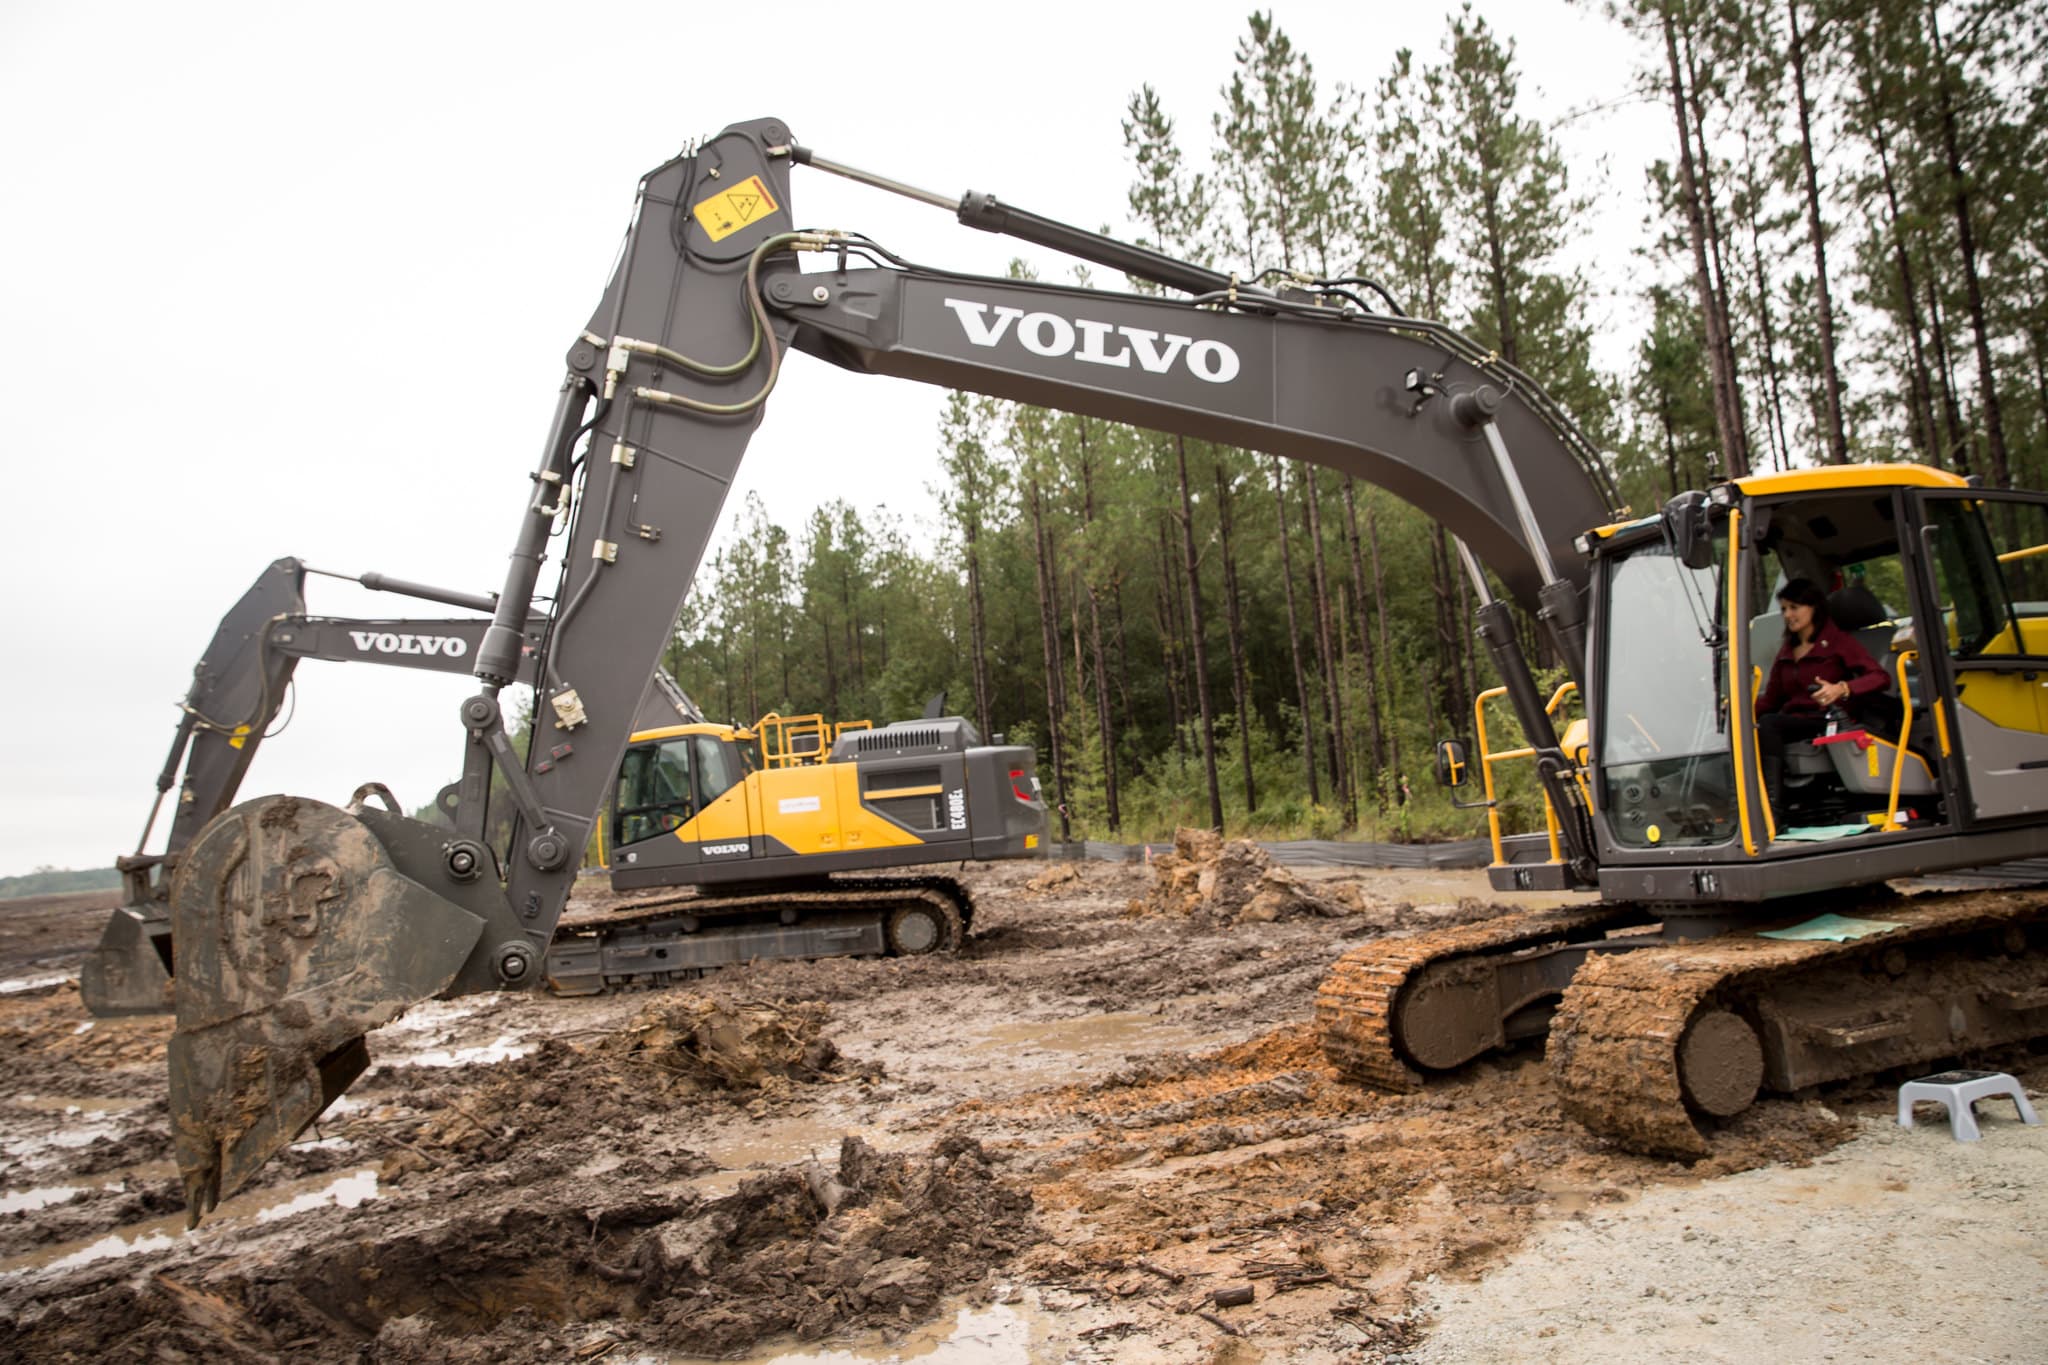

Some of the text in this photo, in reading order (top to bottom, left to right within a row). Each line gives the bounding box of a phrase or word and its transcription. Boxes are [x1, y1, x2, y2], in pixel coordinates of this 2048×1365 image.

[944, 298, 1240, 384] VOLVO
[349, 631, 468, 657] VOLVO
[701, 843, 750, 856] VOLVO
